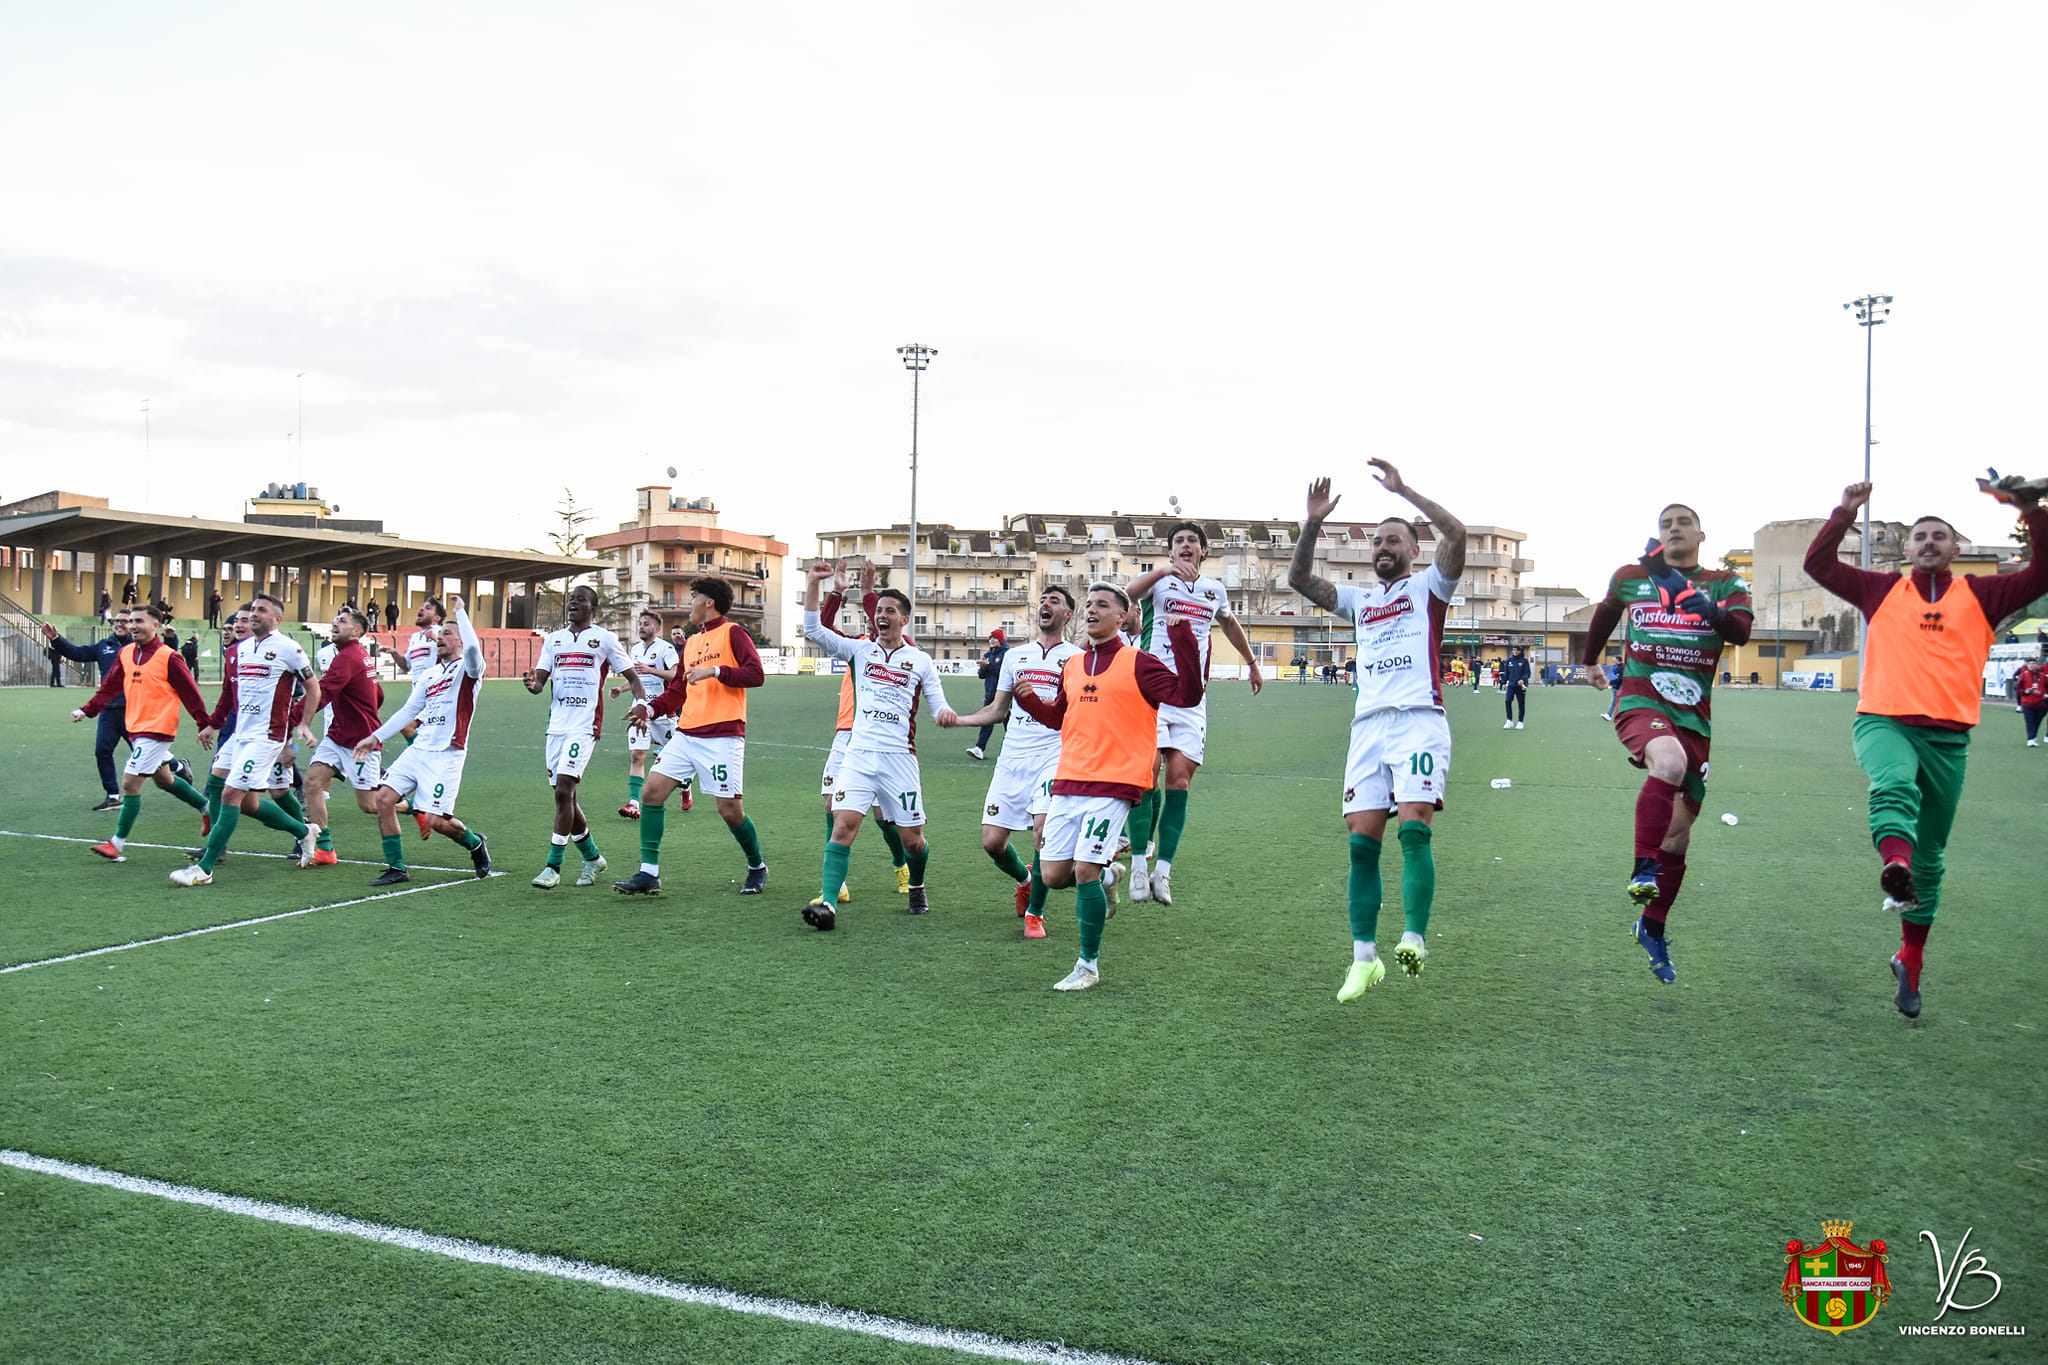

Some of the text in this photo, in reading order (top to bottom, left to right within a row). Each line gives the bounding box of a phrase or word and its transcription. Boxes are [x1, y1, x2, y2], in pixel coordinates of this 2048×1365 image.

[1665, 647, 1701, 656] TONIOLO
[1376, 655, 1412, 670] ZODA
[1666, 654, 1682, 662] SAN
[1683, 656, 1714, 666] CATALDO
[873, 710, 900, 722] ZODA
[568, 742, 580, 759] 8
[243, 759, 255, 774] 6
[355, 761, 365, 776] 7
[1409, 751, 1434, 776] 10
[710, 764, 728, 782] 15
[433, 783, 445, 799] 9
[898, 791, 917, 811] 17
[1085, 817, 1111, 842] 14
